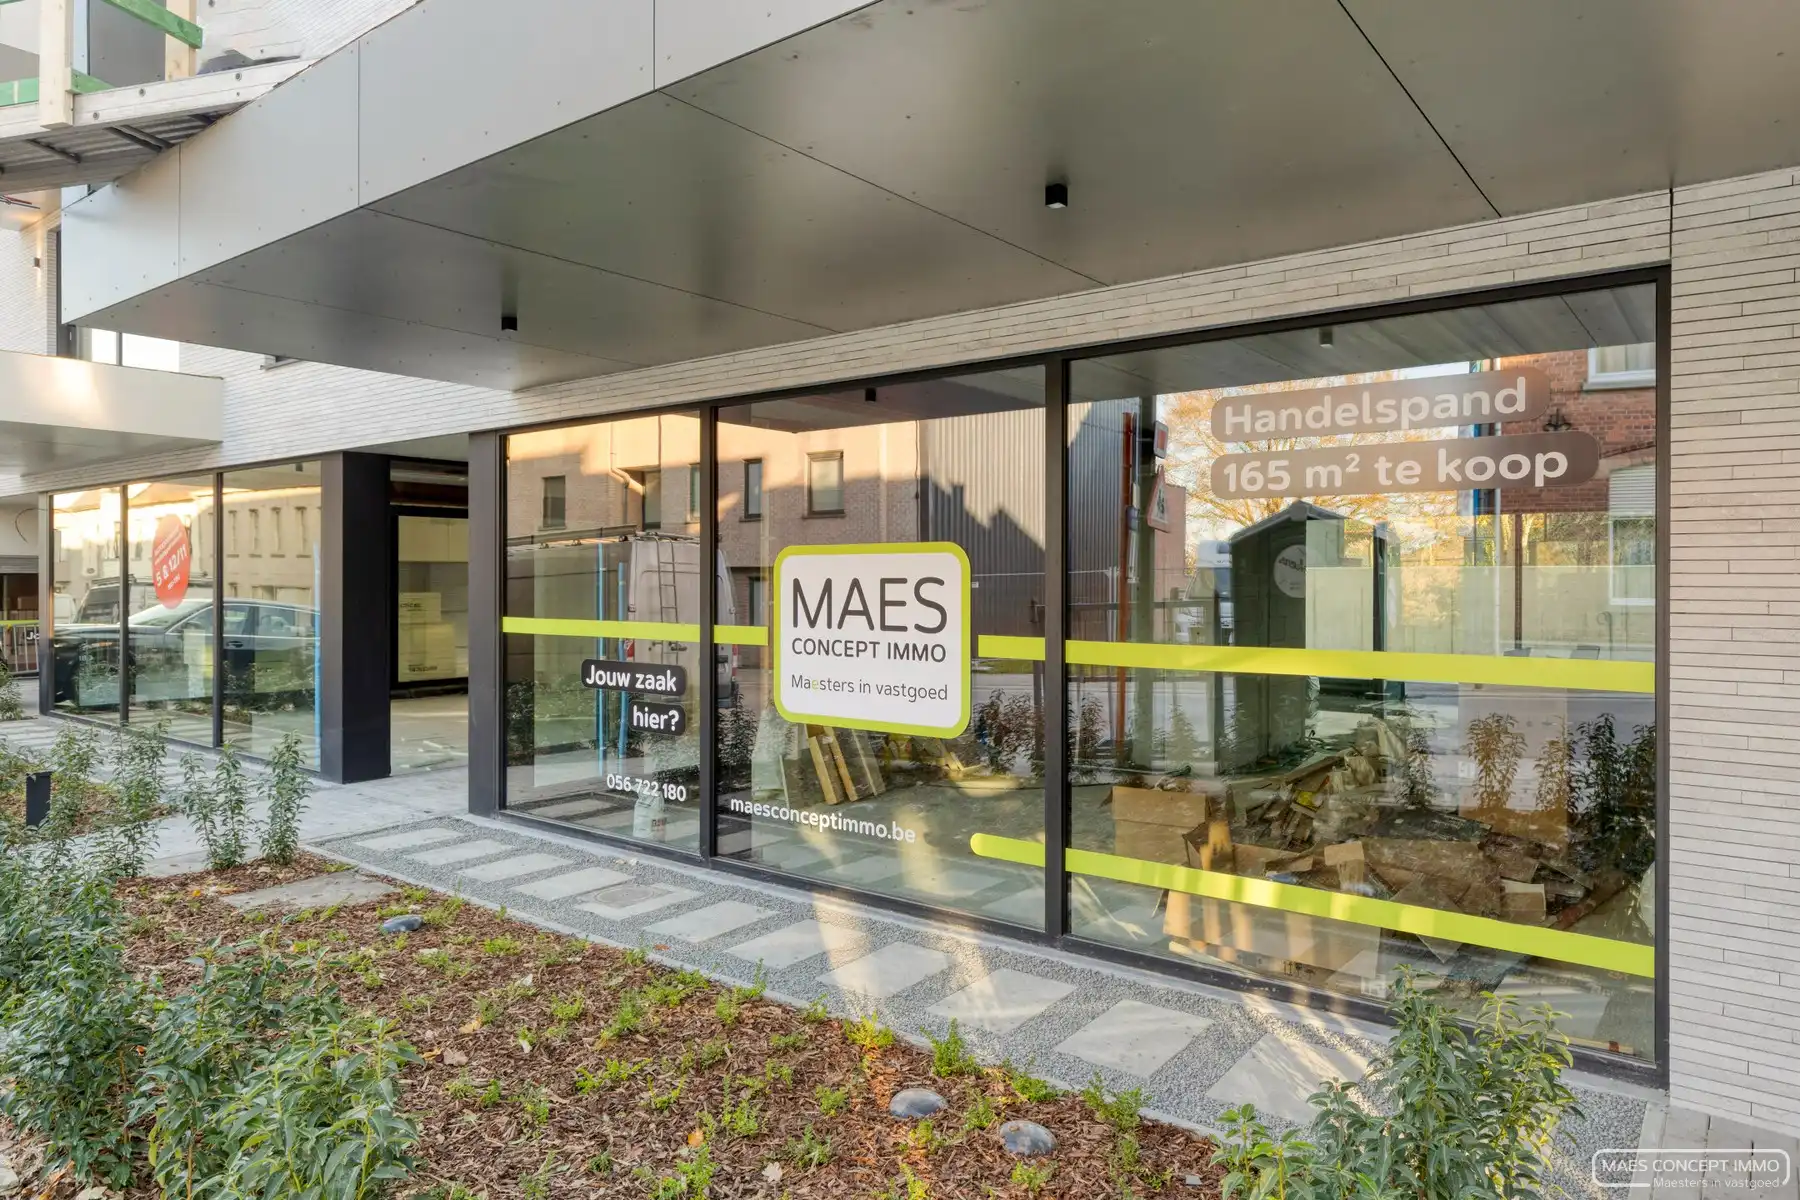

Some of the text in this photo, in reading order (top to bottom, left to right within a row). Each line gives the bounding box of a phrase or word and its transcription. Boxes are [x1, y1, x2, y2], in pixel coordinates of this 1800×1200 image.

[1225, 376, 1526, 436] Handelspand
[1223, 460, 1291, 493] 165
[1374, 456, 1422, 486] te
[1437, 448, 1568, 487] koop
[792, 576, 948, 634] MAES
[792, 637, 947, 663] CONCEPT IMMO
[585, 664, 677, 692] Jouw zaak
[791, 674, 948, 703] Maesters in vastgoed
[633, 704, 680, 731] hier?
[606, 773, 687, 802] 056 722 180
[730, 798, 916, 843] maesconceptimmo.be
